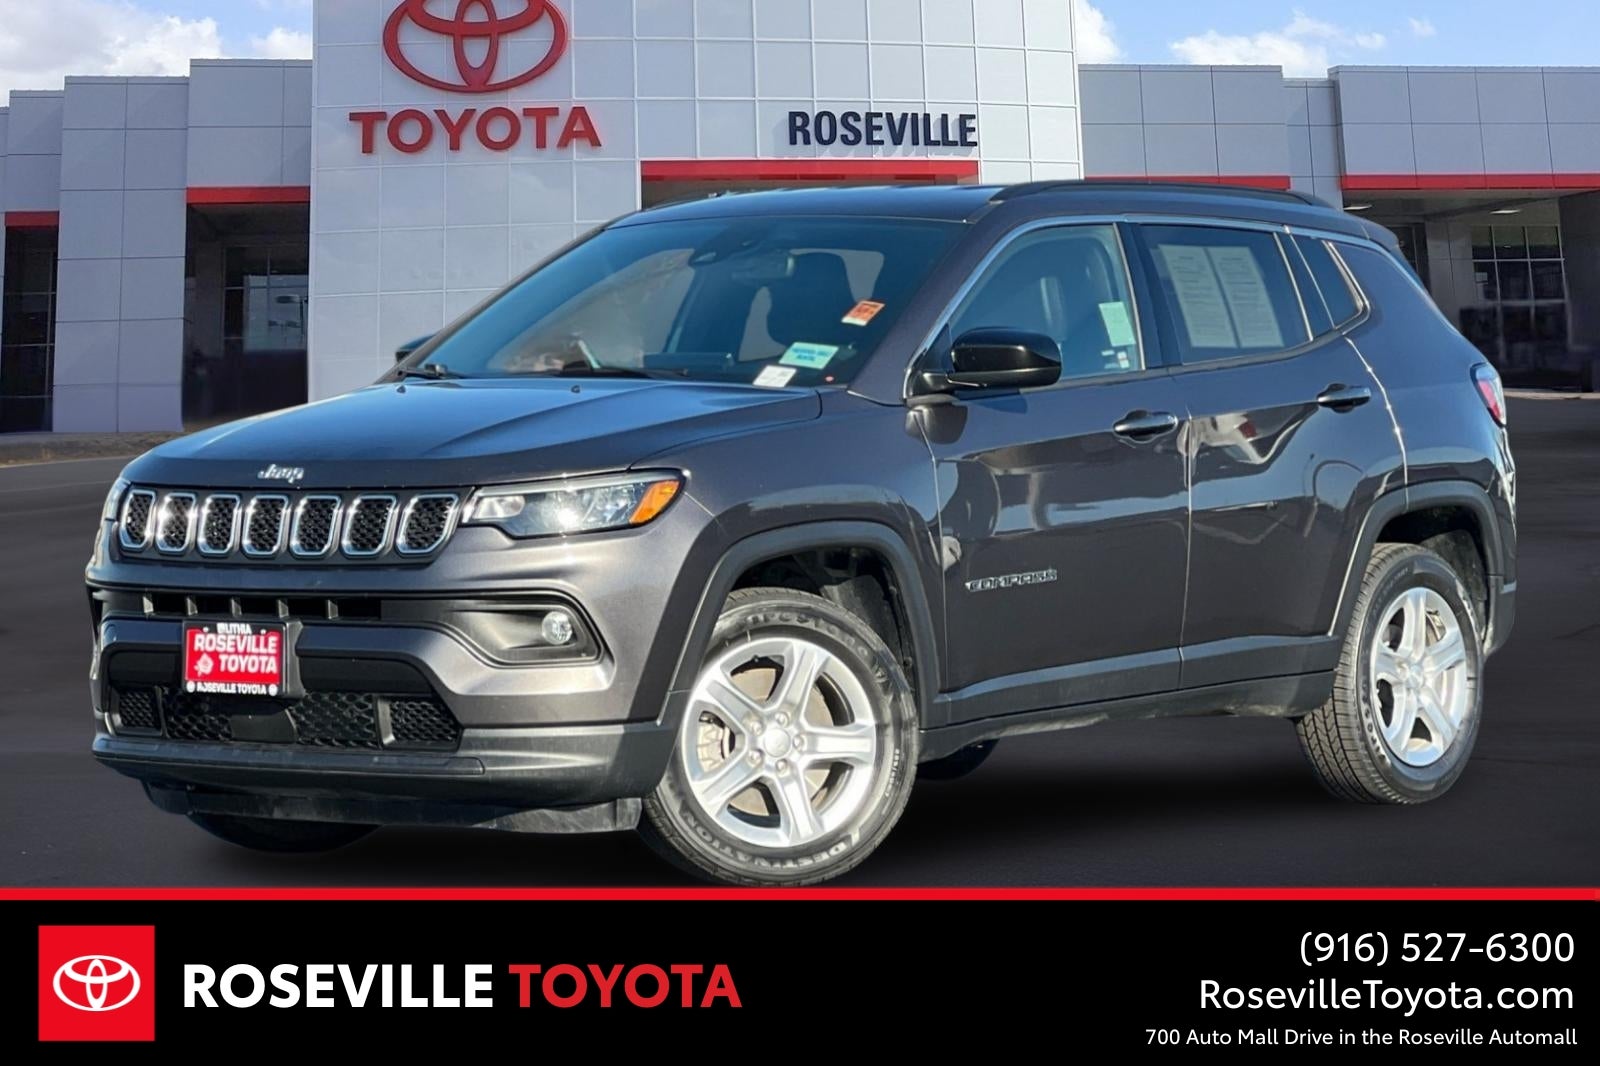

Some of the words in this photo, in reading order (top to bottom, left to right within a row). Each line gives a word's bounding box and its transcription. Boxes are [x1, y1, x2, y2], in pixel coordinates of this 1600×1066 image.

[349, 106, 602, 154] TOYOTA
[788, 110, 978, 147] ROSEVILLE
[257, 463, 304, 484] Jeep
[964, 568, 1057, 592] COMPASS
[194, 633, 278, 653] ROSEVILLE
[219, 654, 277, 674] TOYOTA
[196, 681, 236, 694] ROSEVILLE
[237, 683, 267, 696] TOYOTA
